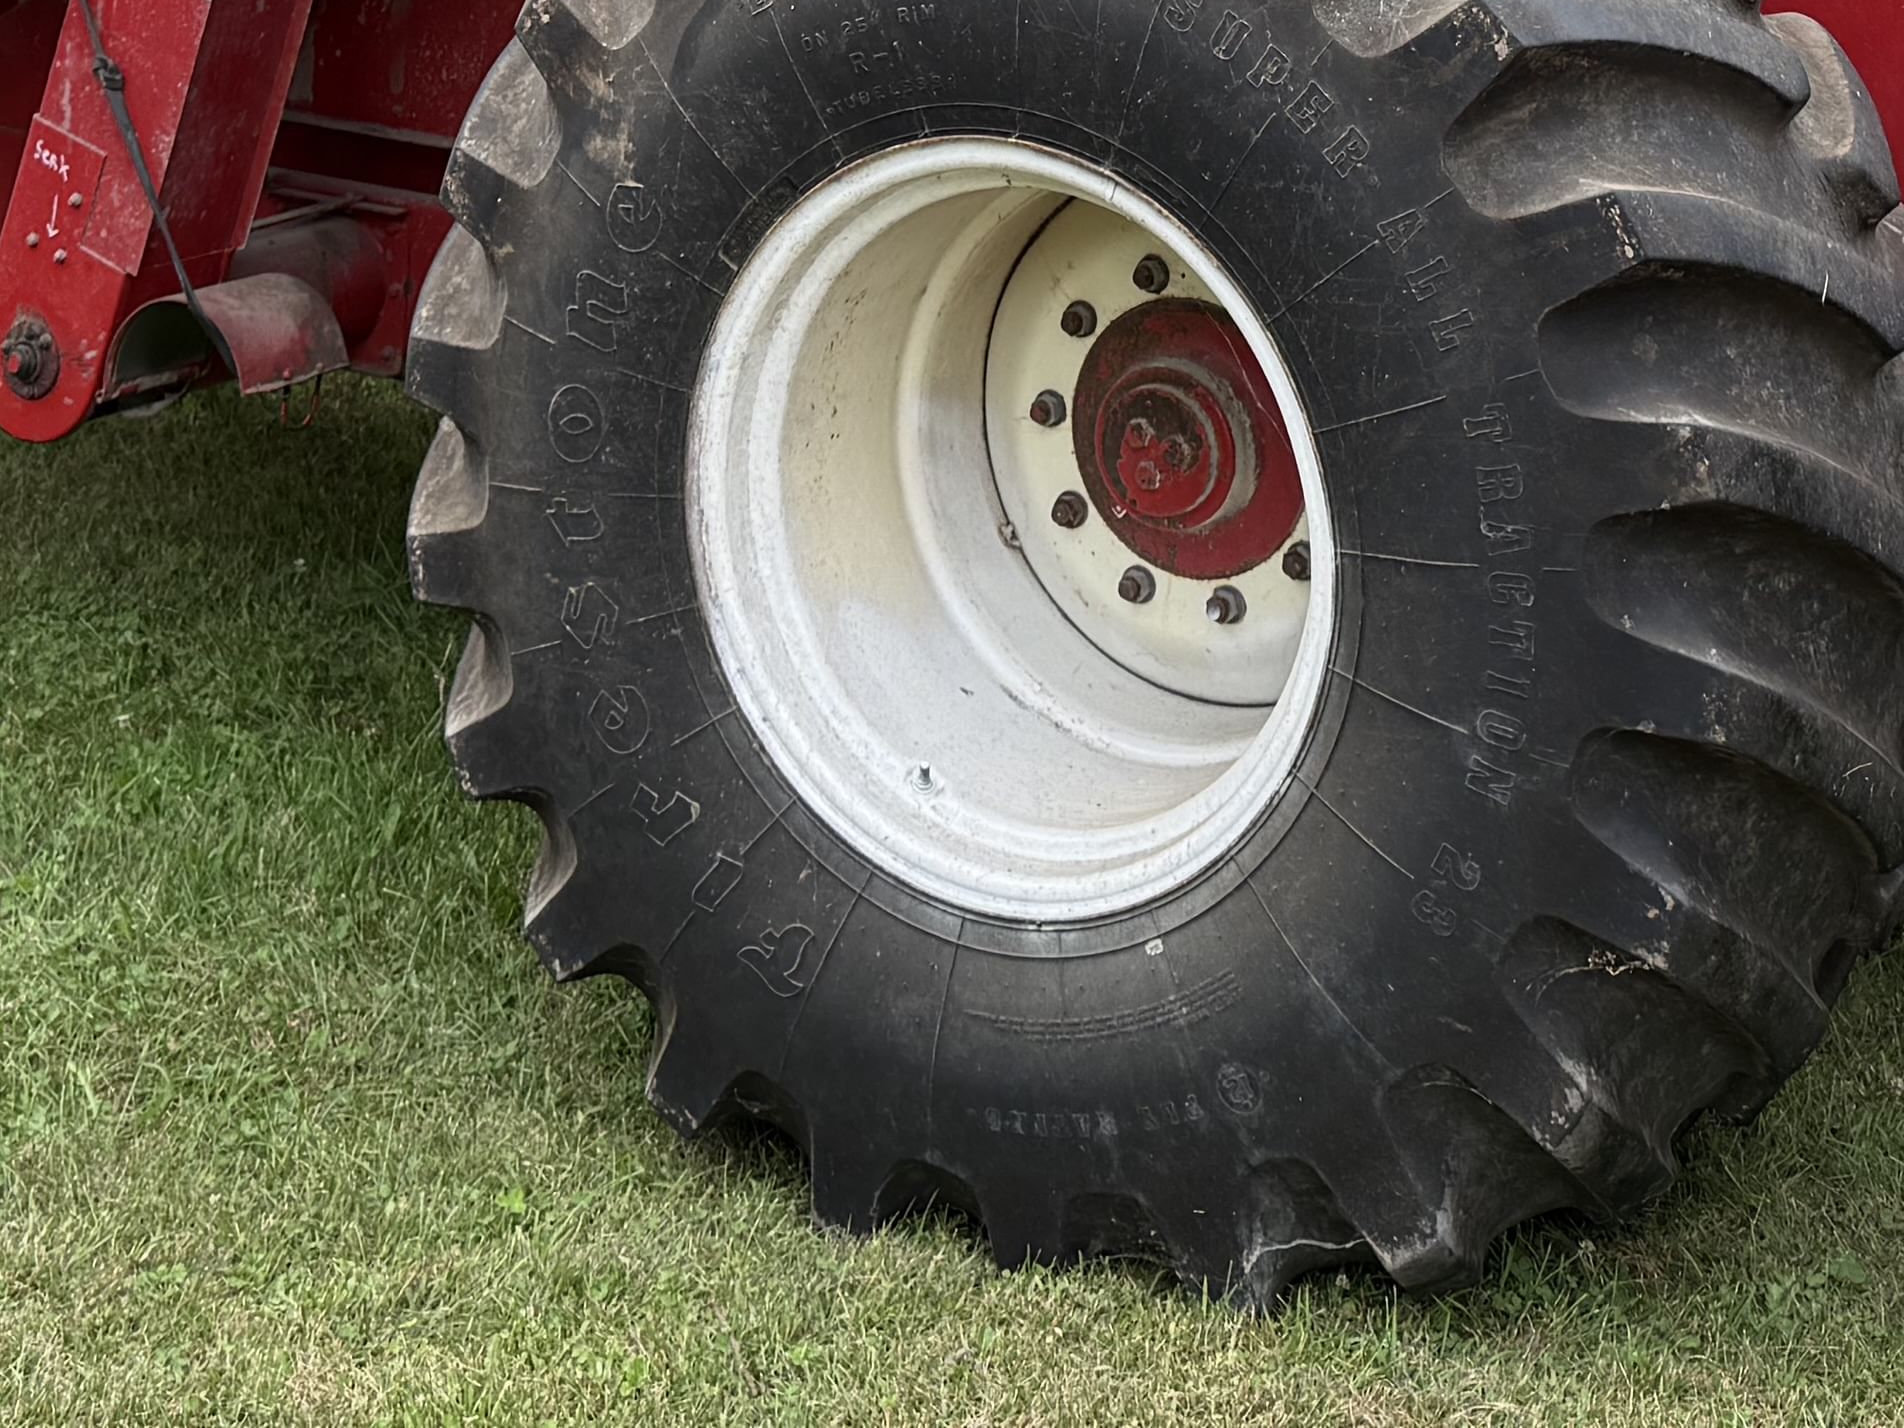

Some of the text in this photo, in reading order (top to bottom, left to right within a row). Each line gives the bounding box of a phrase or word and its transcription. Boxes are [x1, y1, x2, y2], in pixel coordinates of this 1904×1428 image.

[896, 2, 936, 26] RIM
[545, 179, 816, 999] Firestone
[1378, 207, 1470, 352] ALL
[1462, 401, 1537, 808] TRACTION
